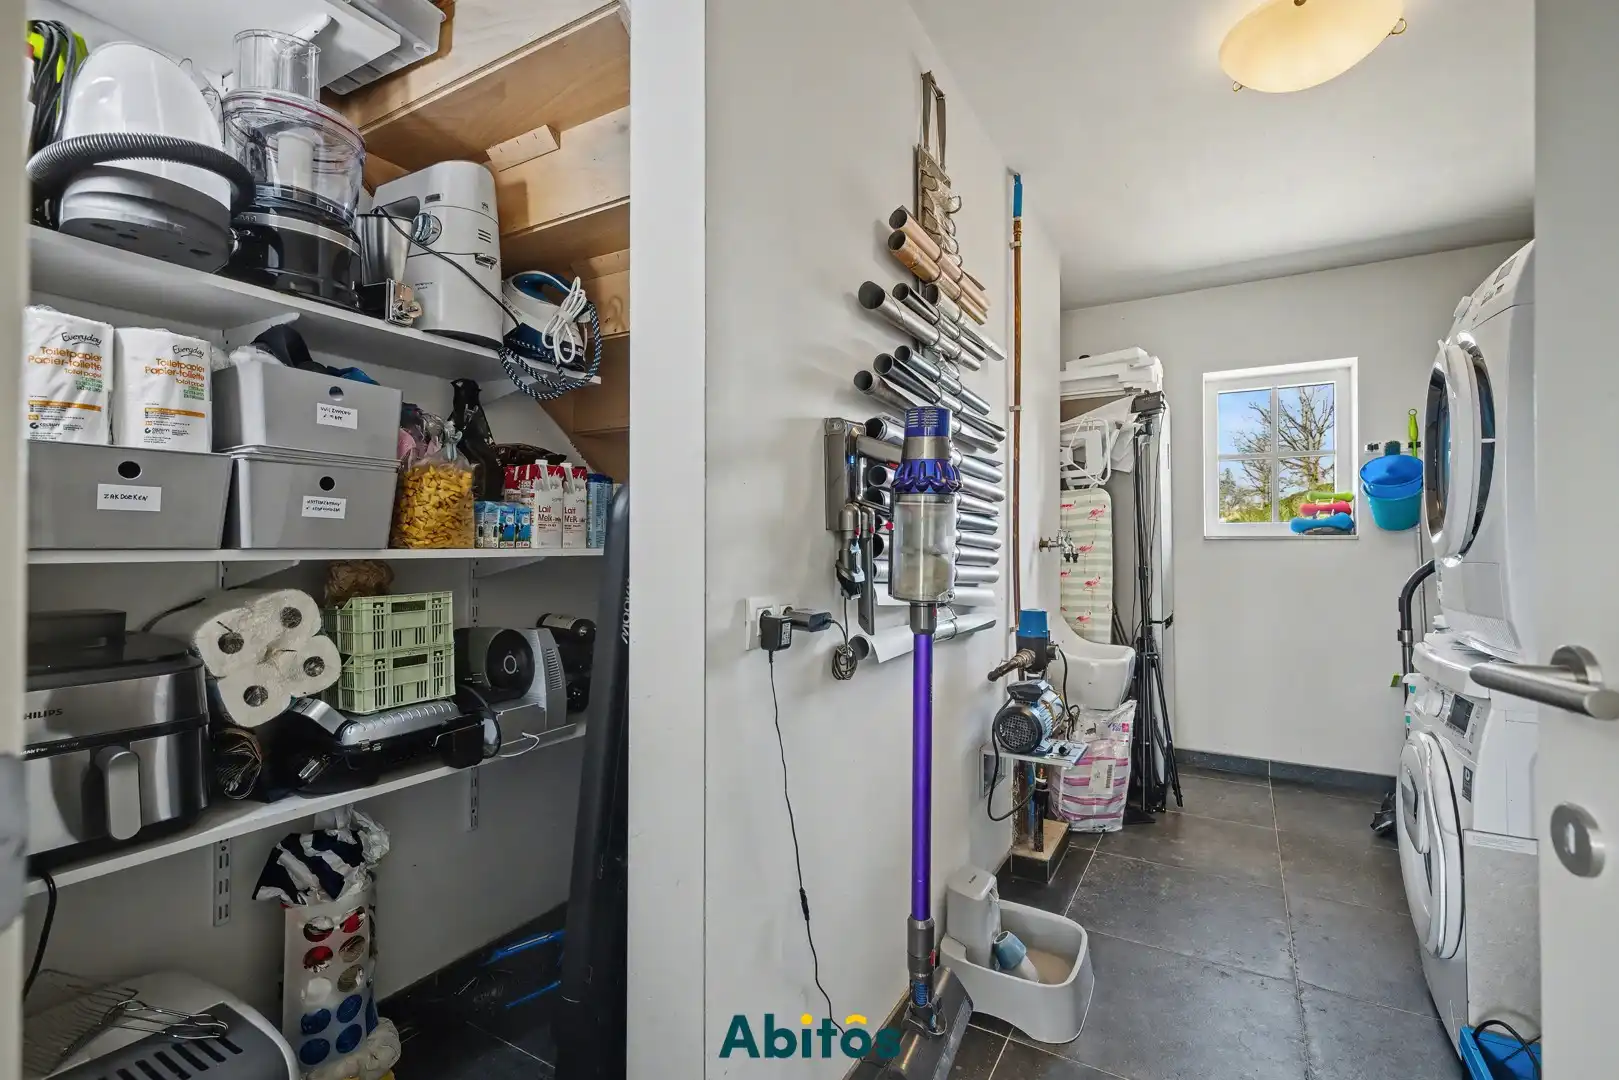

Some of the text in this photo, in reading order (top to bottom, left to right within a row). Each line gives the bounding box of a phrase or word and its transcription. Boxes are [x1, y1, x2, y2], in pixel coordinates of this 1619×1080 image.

[61, 331, 102, 346] Everyday
[40, 346, 102, 362] Toiletpapier
[172, 344, 205, 359] Everyday
[28, 355, 102, 372] Papier-toilette
[156, 358, 205, 373] Toiletpapier
[145, 366, 205, 381] Papier-toilette
[538, 505, 551, 513] Lait
[564, 506, 576, 515] Lait
